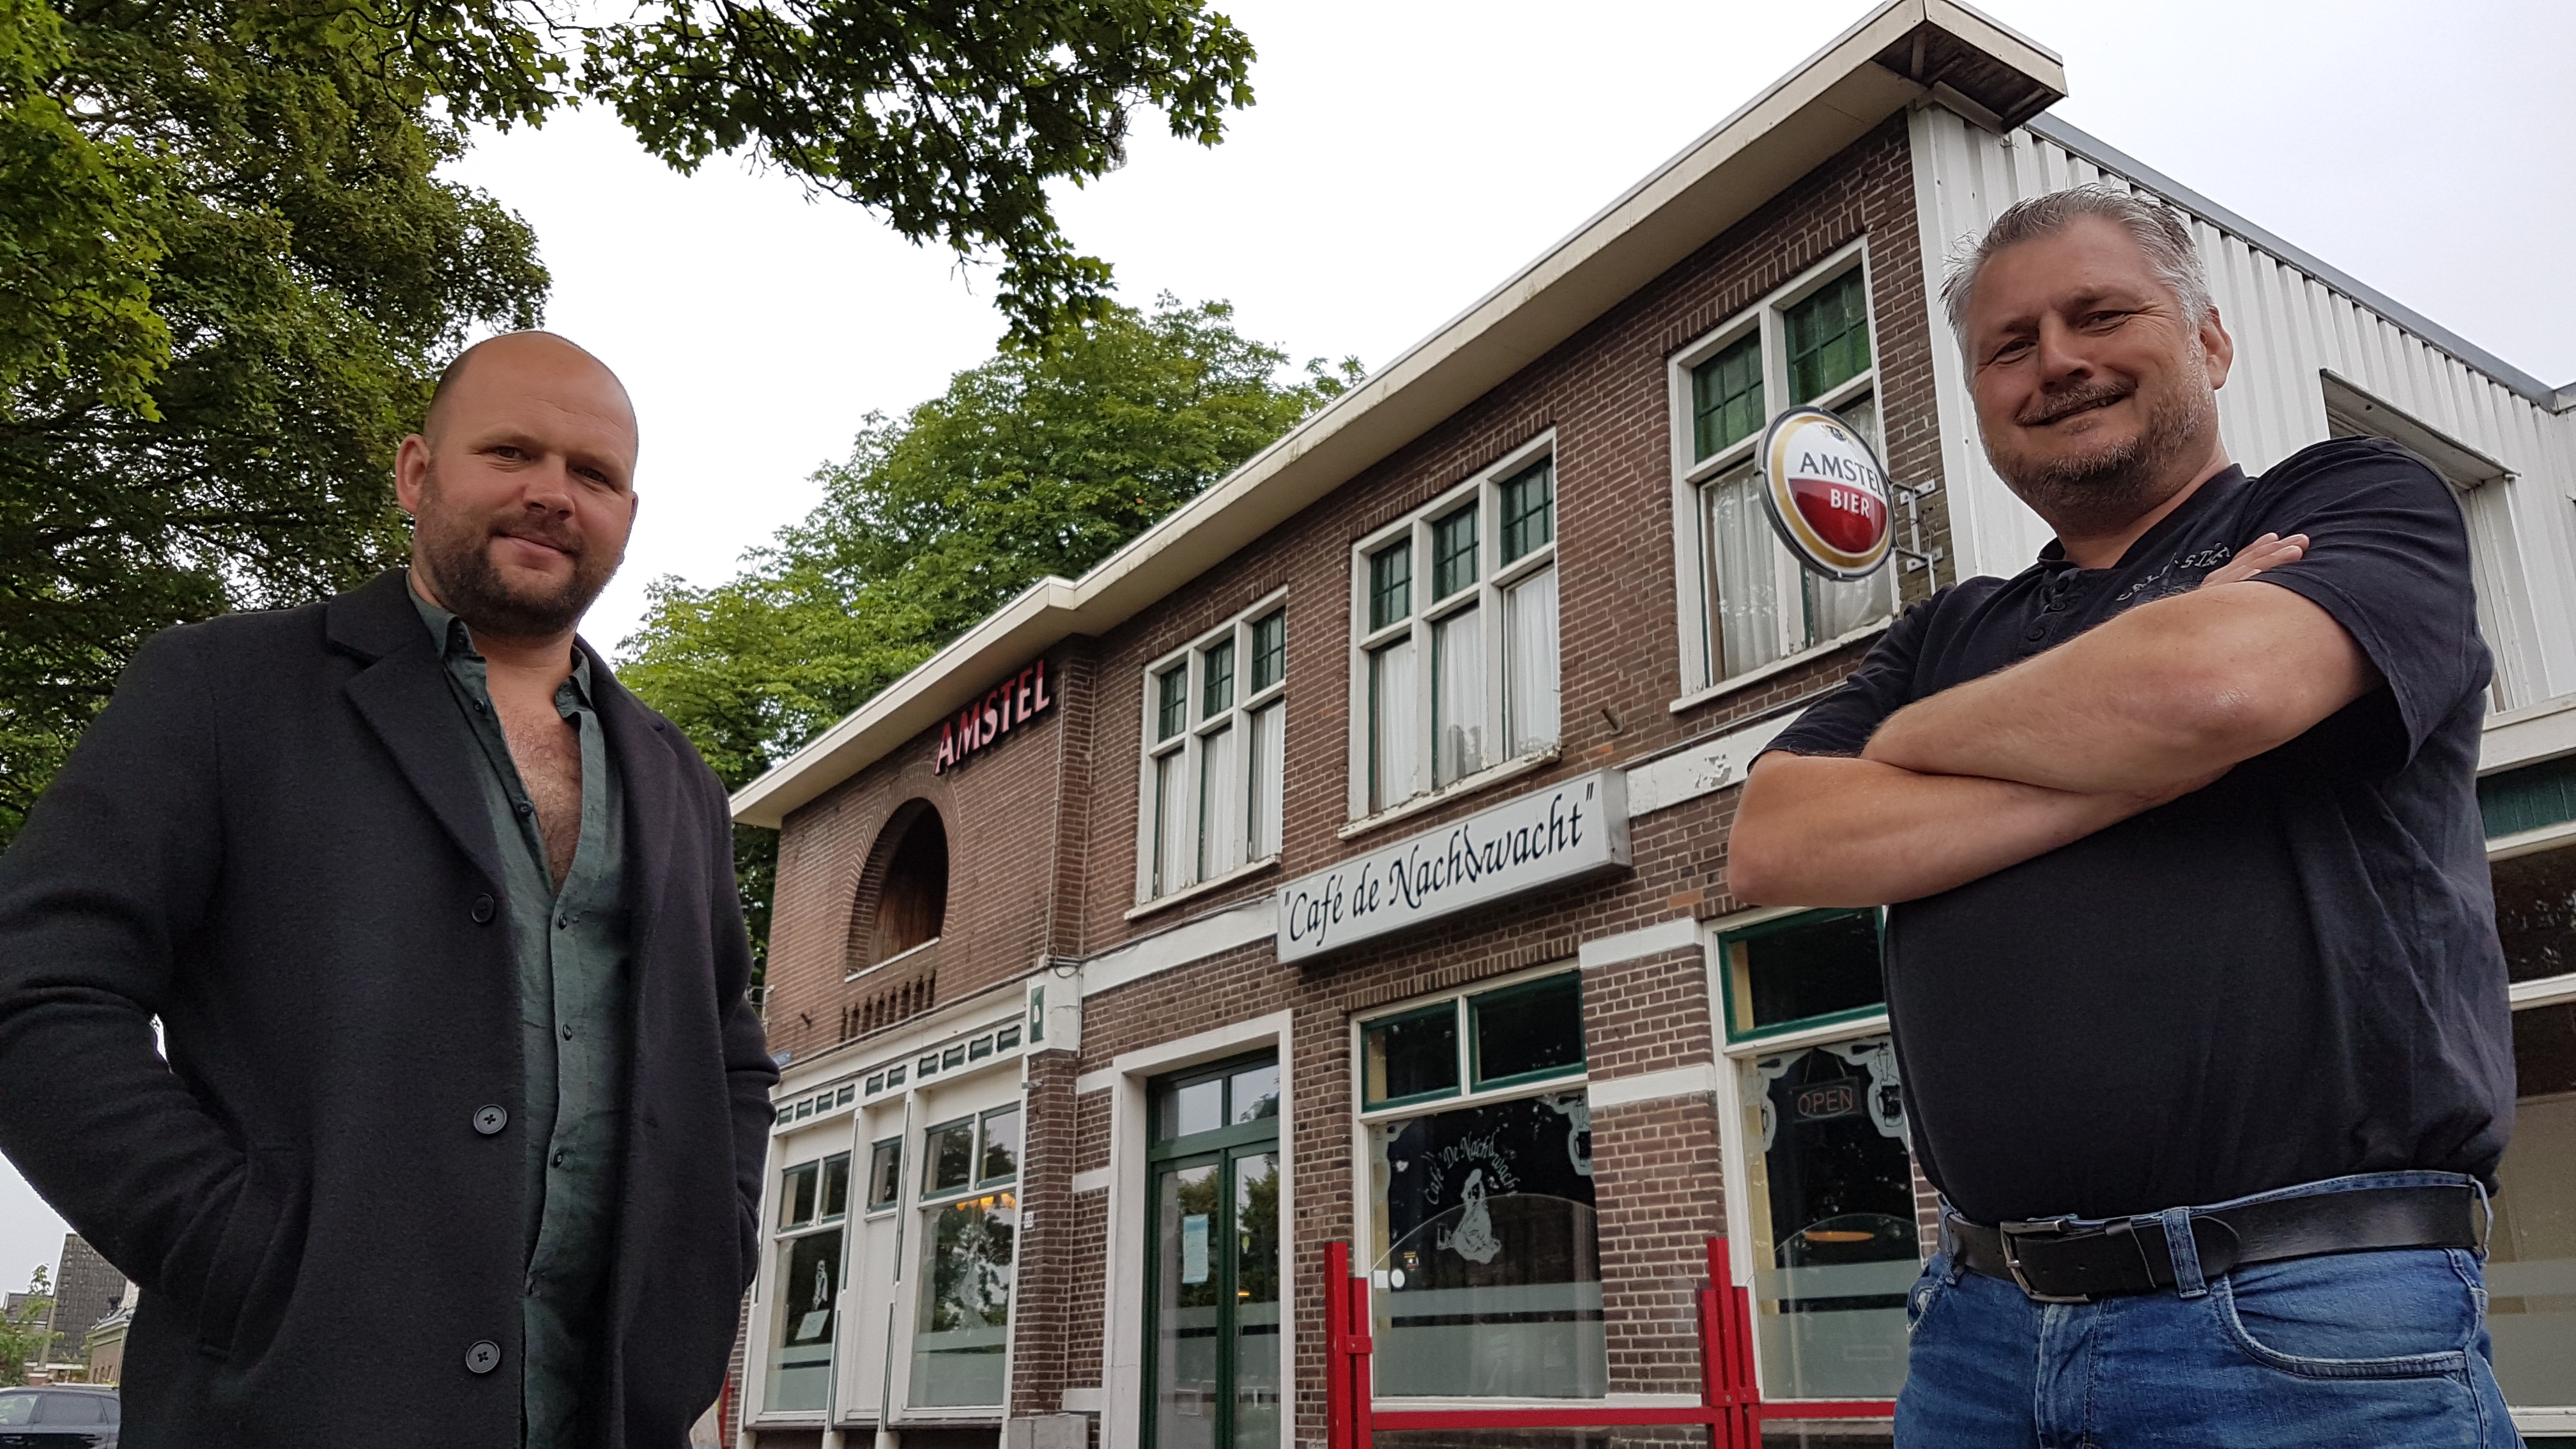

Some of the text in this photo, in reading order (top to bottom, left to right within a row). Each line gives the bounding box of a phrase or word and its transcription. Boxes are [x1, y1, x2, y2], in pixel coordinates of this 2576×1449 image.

[1800, 451, 1883, 497] AMSTEL
[1830, 488, 1870, 519] BIER
[933, 659, 1050, 774] AMSTEL
[1353, 861, 1381, 918] de
[1798, 1089, 1852, 1115] OPEN
